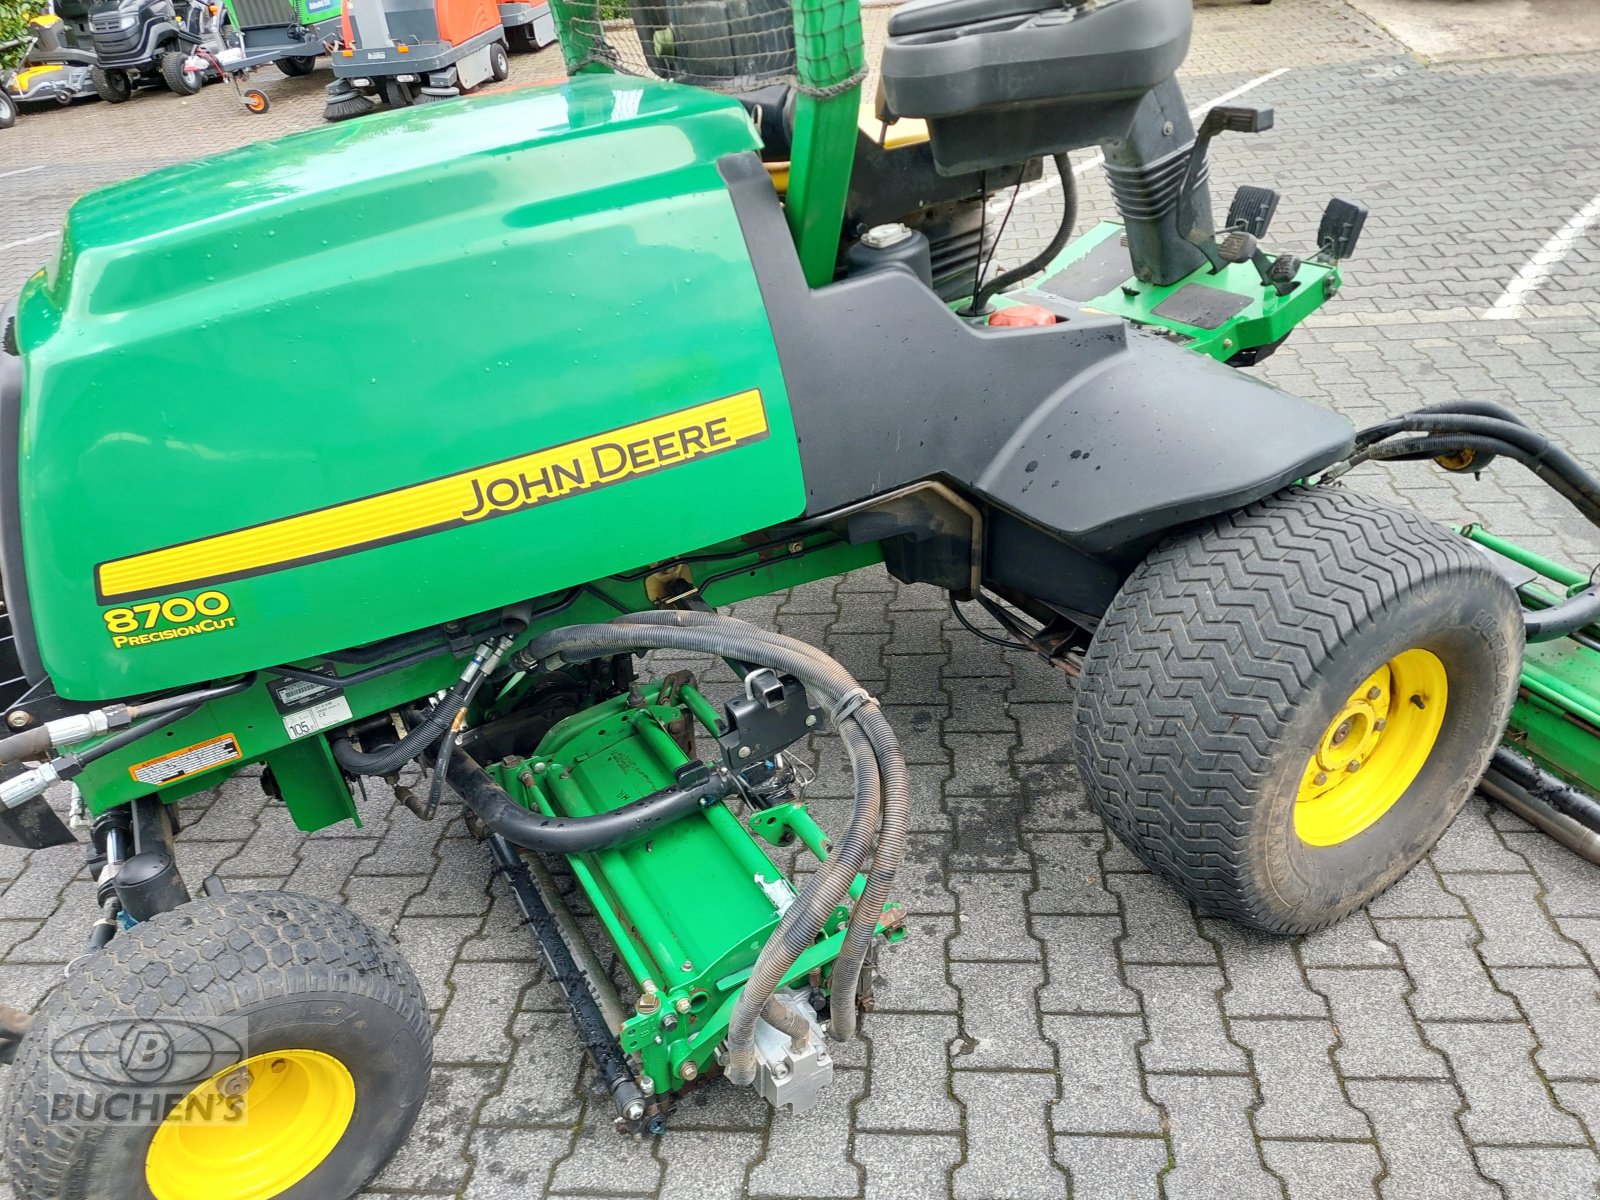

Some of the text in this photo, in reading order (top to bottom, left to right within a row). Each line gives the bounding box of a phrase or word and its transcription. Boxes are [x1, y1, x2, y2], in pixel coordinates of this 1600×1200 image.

[461, 416, 732, 517] JOHN DEERE
[103, 590, 231, 634] 8700
[289, 720, 310, 738] 105
